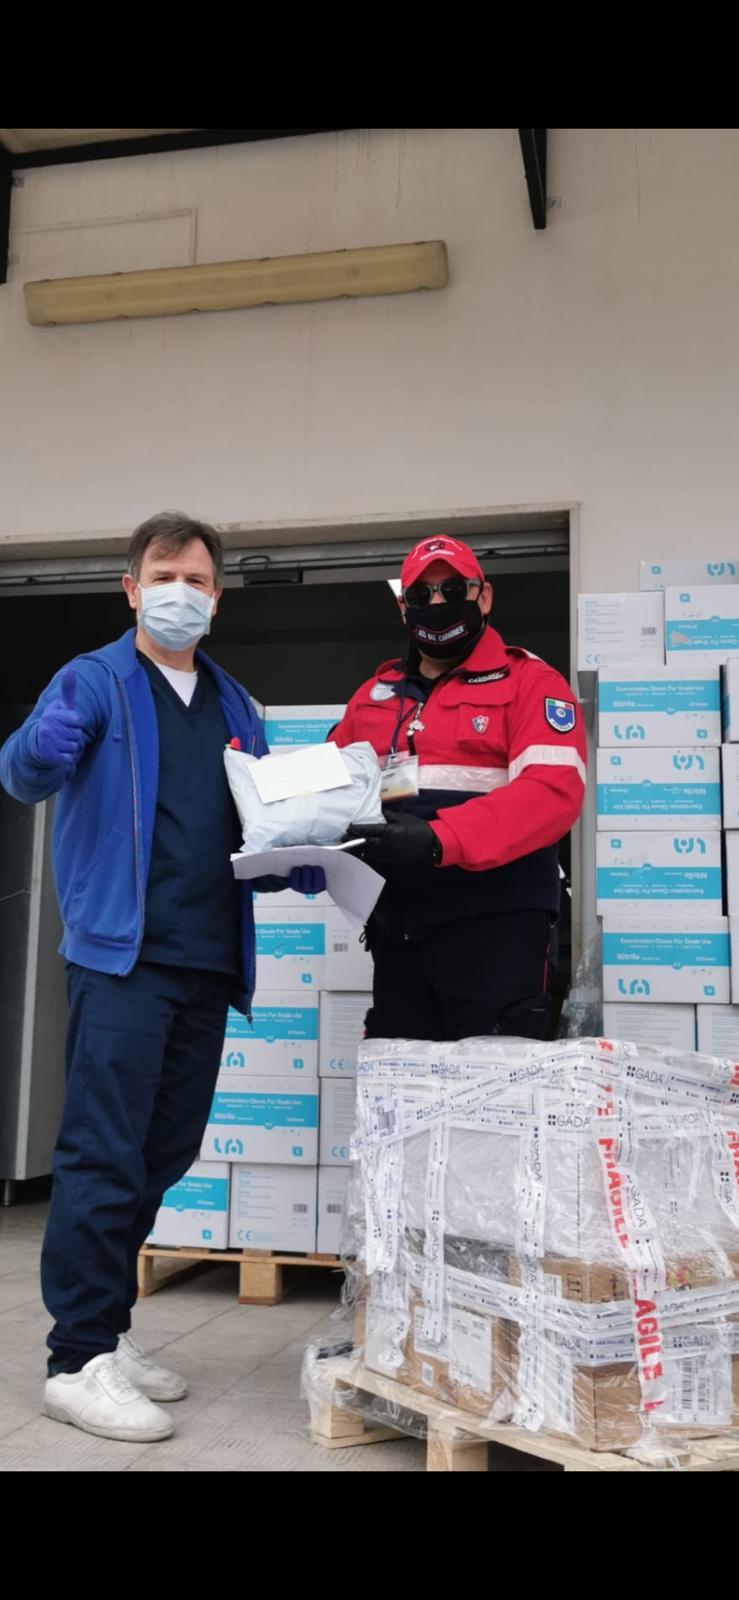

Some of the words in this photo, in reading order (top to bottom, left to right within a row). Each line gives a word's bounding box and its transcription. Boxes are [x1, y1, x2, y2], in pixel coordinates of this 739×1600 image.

[518, 1063, 545, 1079] GADA
[635, 1068, 664, 1085] GADA
[556, 1116, 590, 1128] GADA
[630, 1186, 648, 1229] GADA
[633, 1290, 664, 1381] AGILE
